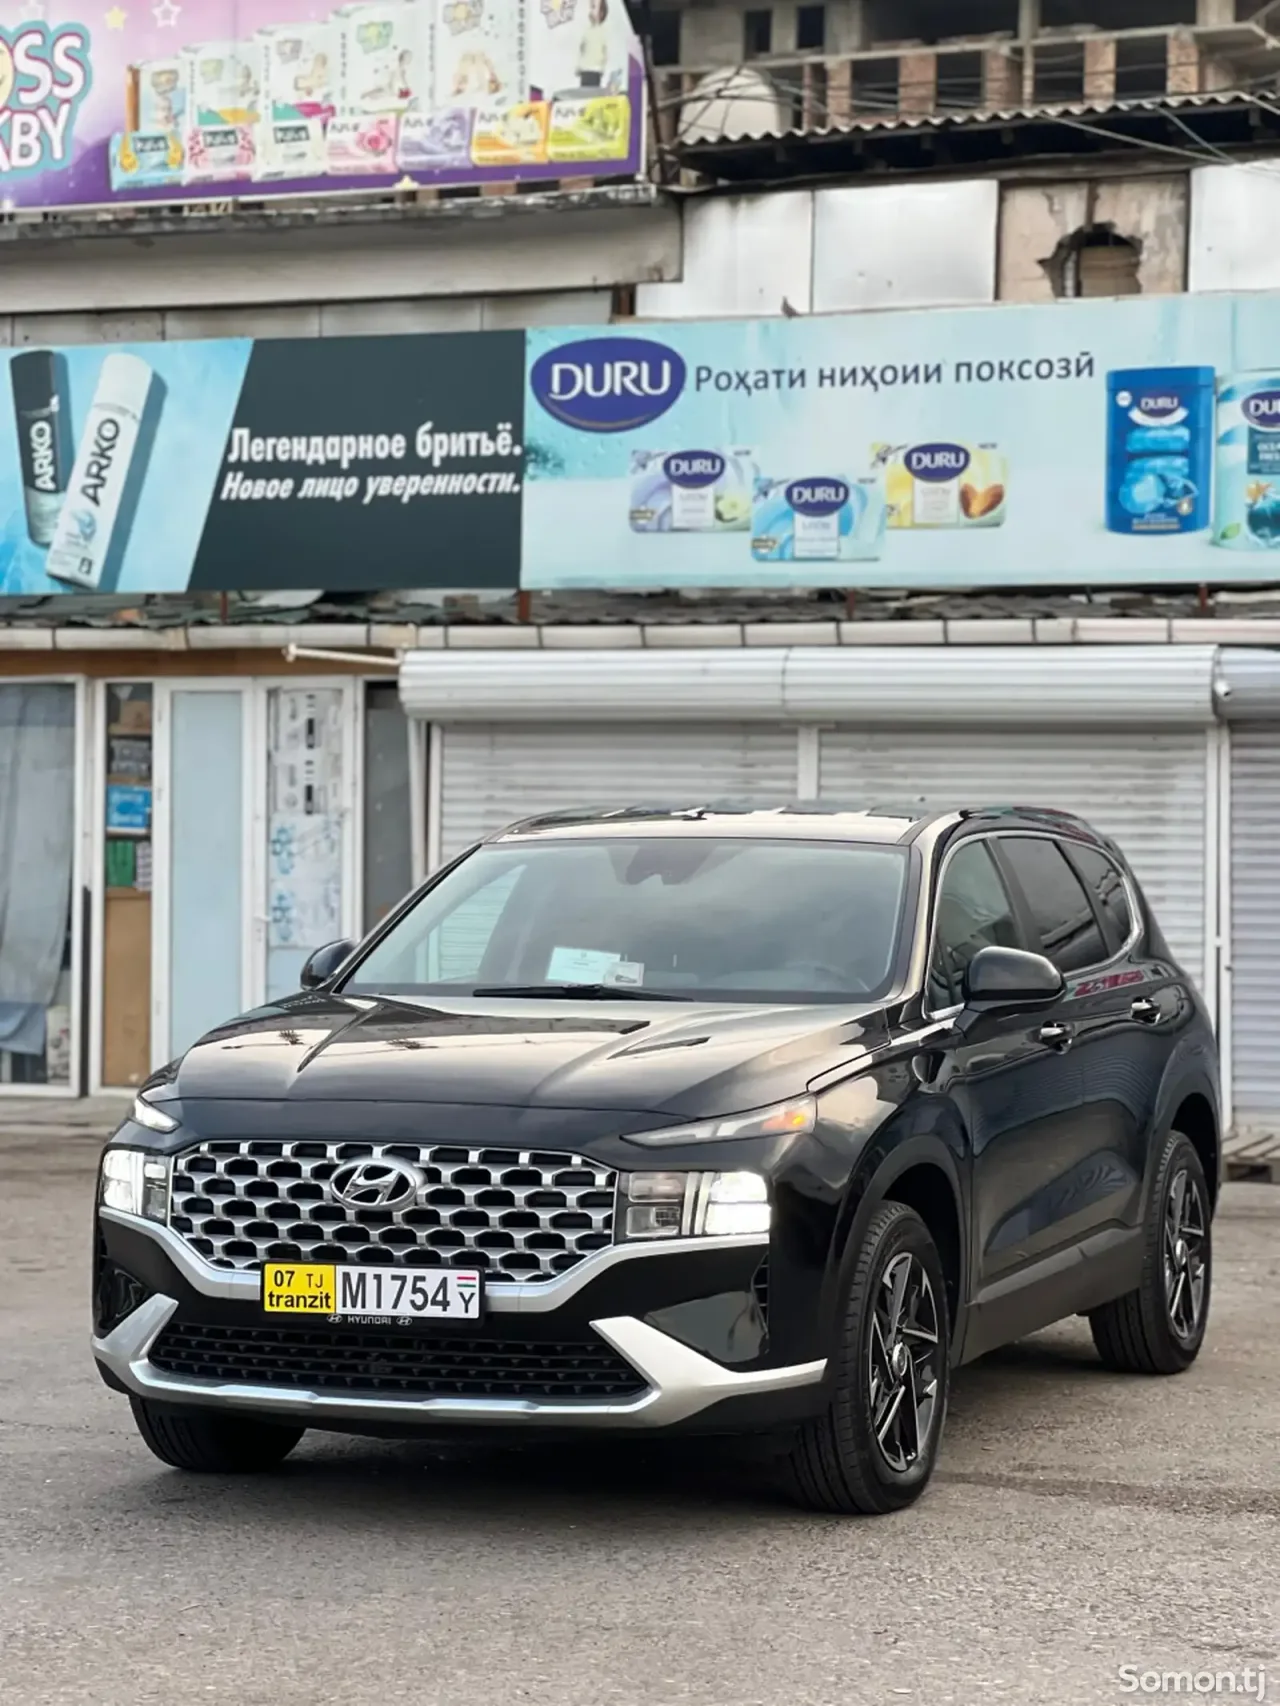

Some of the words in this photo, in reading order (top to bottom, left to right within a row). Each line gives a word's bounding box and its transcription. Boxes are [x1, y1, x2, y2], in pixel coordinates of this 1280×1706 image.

[548, 360, 671, 400] DURU
[695, 365, 806, 397] Роҳати
[818, 363, 942, 392] ниҳоии
[954, 351, 1094, 383] поксозӣ
[1249, 399, 1280, 417] DU
[29, 419, 57, 492] ARKO
[227, 427, 407, 469] Легендарное
[415, 420, 523, 467] бритьё.
[80, 418, 120, 507] ARKO
[670, 458, 721, 476] DURU
[911, 451, 966, 470] DURU
[220, 471, 295, 501] Новое
[297, 475, 360, 502] лицо
[362, 471, 521, 505] уверенности.
[791, 486, 845, 504] DURU
[273, 1270, 295, 1287] 07
[306, 1273, 324, 1289] TJ
[341, 1271, 450, 1312] M1754
[459, 1291, 476, 1314] Y
[268, 1290, 331, 1309] tranzit
[347, 1315, 391, 1325] HYUNDAI
